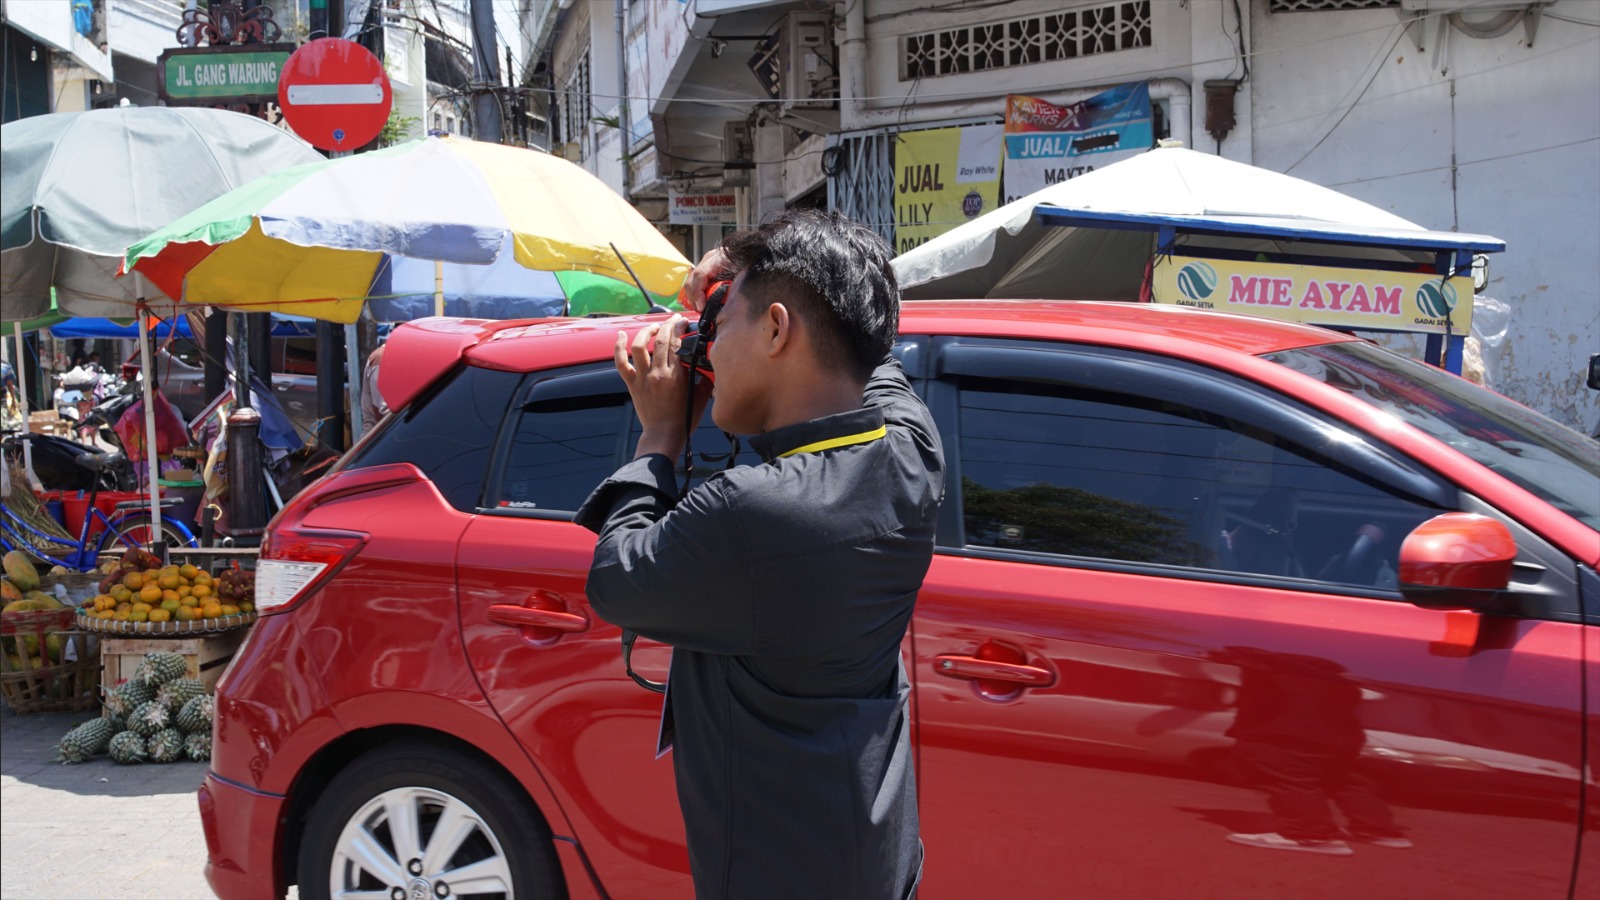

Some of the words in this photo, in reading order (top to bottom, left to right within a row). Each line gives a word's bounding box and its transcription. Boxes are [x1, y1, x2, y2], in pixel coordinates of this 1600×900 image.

[176, 65, 192, 86] JL.
[194, 63, 226, 86] GANG
[228, 61, 277, 85] WARUNG
[1013, 99, 1060, 115] XAVIER
[1010, 111, 1059, 126] MARKS
[899, 163, 944, 194] JUAL
[960, 167, 974, 177] Ray
[675, 195, 704, 208] PONCO
[899, 202, 933, 227] LILY
[1229, 275, 1293, 307] MIE
[1299, 280, 1403, 315] AYAM
[1197, 301, 1214, 309] SETIA
[1414, 317, 1435, 326] GADAI
[1436, 319, 1454, 327] SETA
